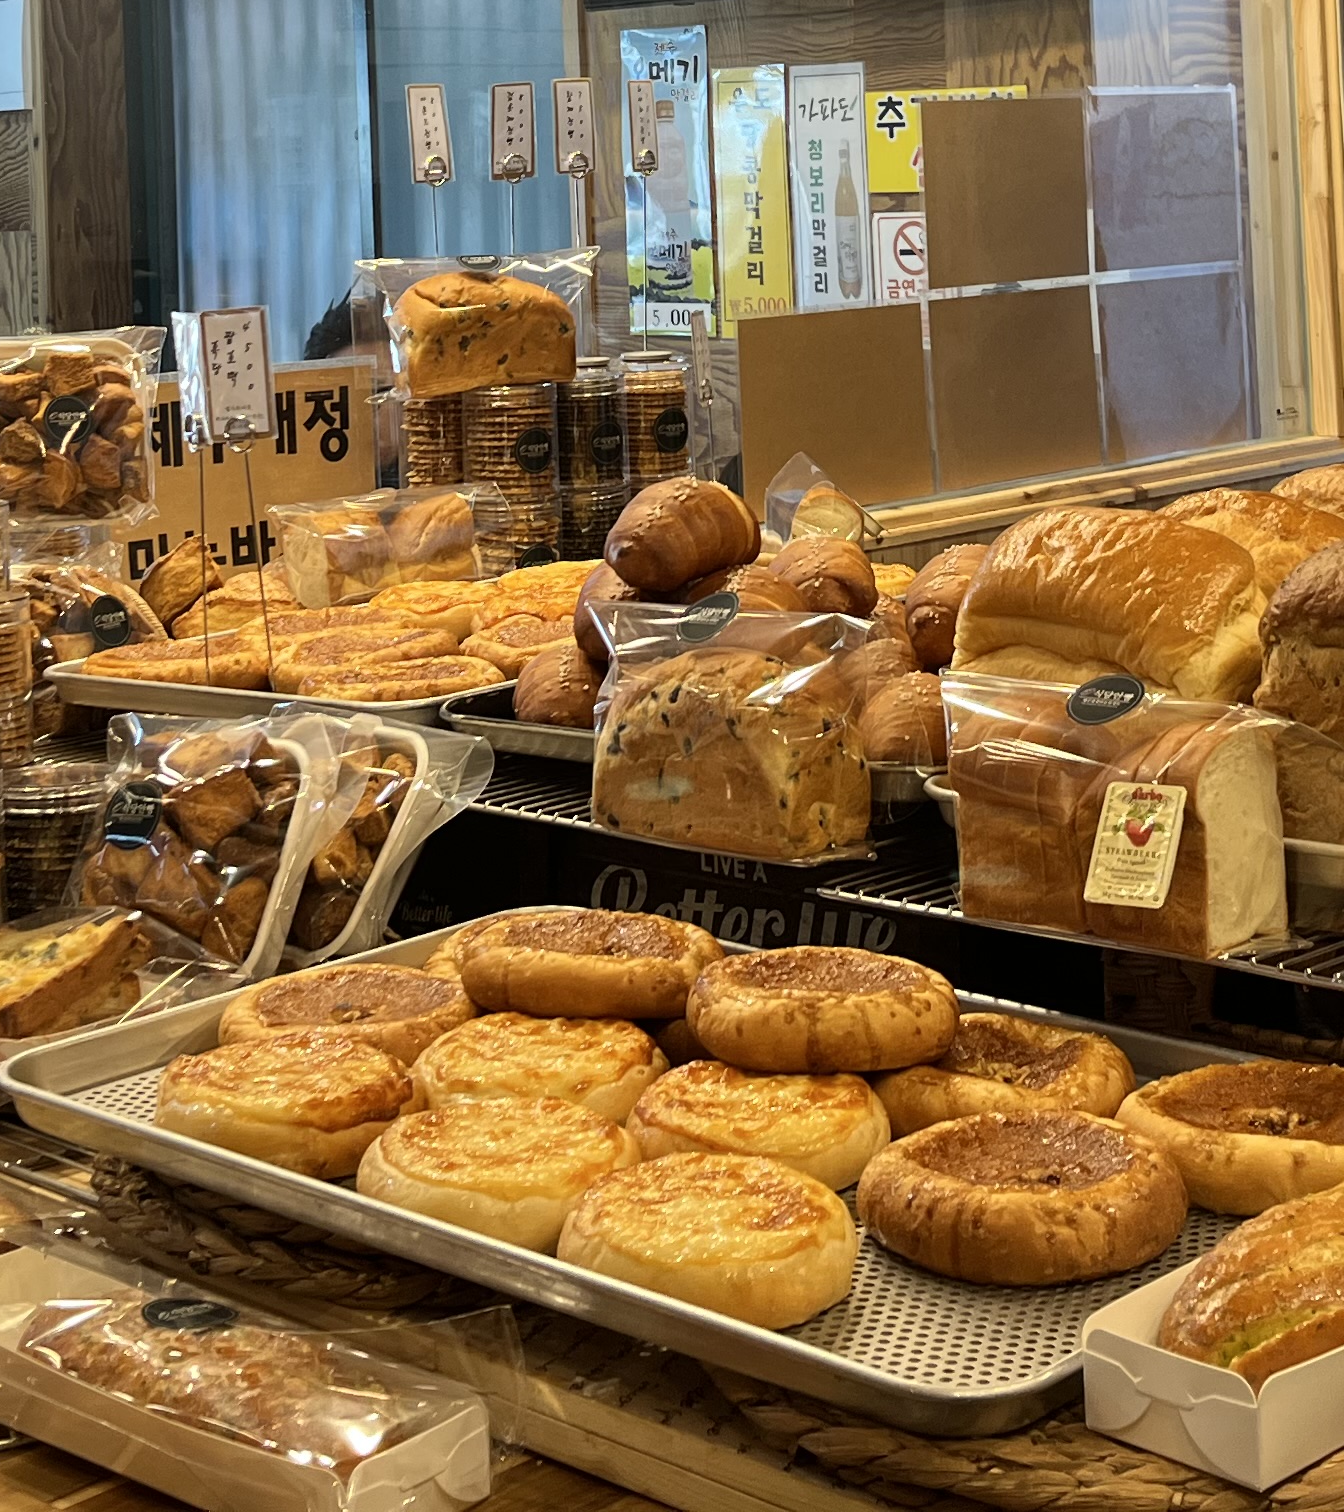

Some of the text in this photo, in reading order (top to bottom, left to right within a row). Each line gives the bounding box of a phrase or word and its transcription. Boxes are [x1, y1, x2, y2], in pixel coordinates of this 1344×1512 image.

[798, 95, 858, 122] 가파도
[808, 139, 829, 294] 청보리막걸리
[242, 321, 255, 390] 4500
[701, 852, 767, 883] LIVE A
